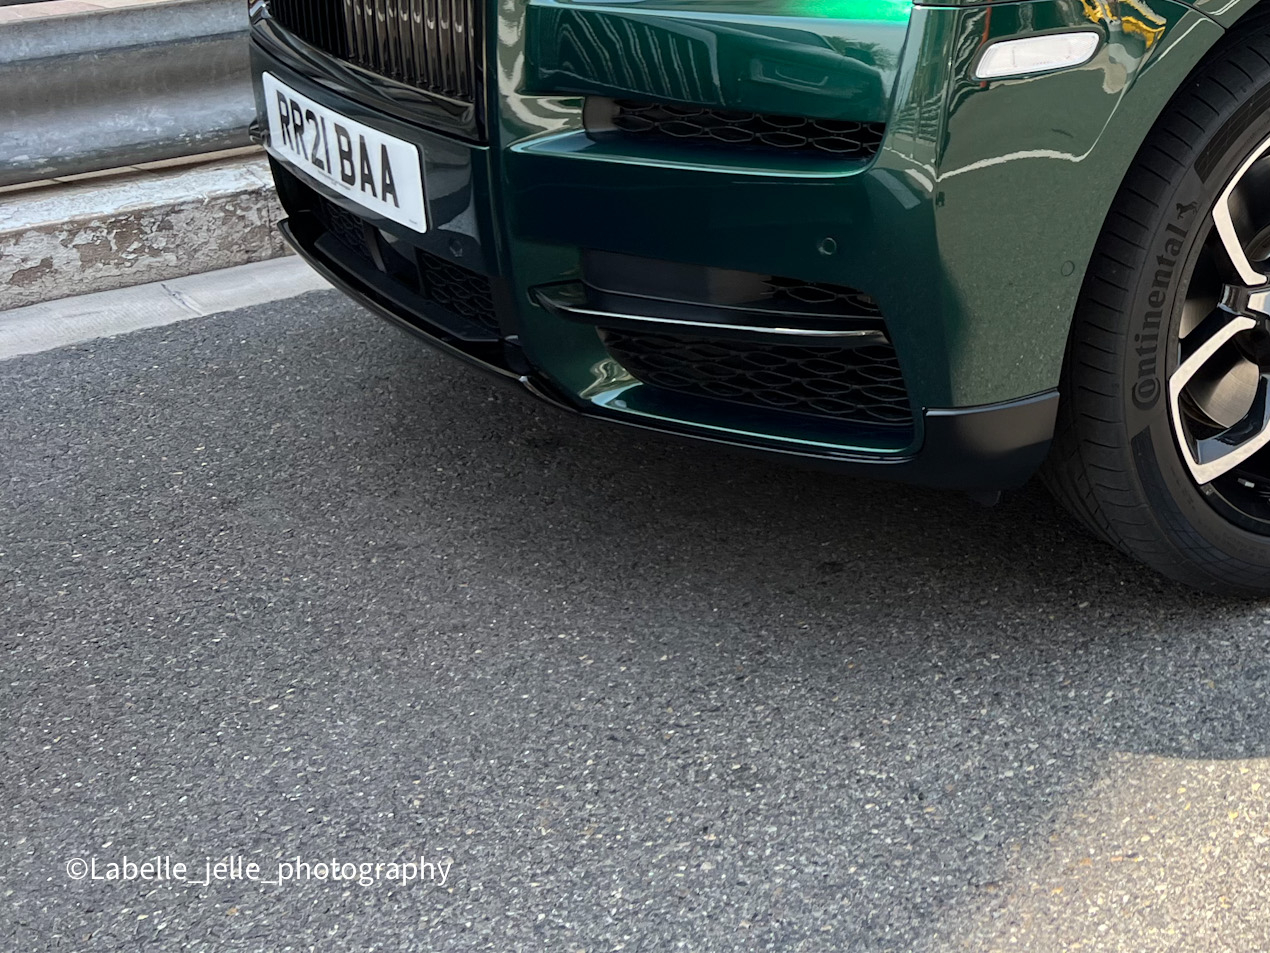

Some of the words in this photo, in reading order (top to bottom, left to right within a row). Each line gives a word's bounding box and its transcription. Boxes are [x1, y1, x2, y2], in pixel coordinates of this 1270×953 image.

[276, 89, 332, 174] RR21
[334, 123, 400, 209] BAA
[1131, 222, 1189, 411] Continental
